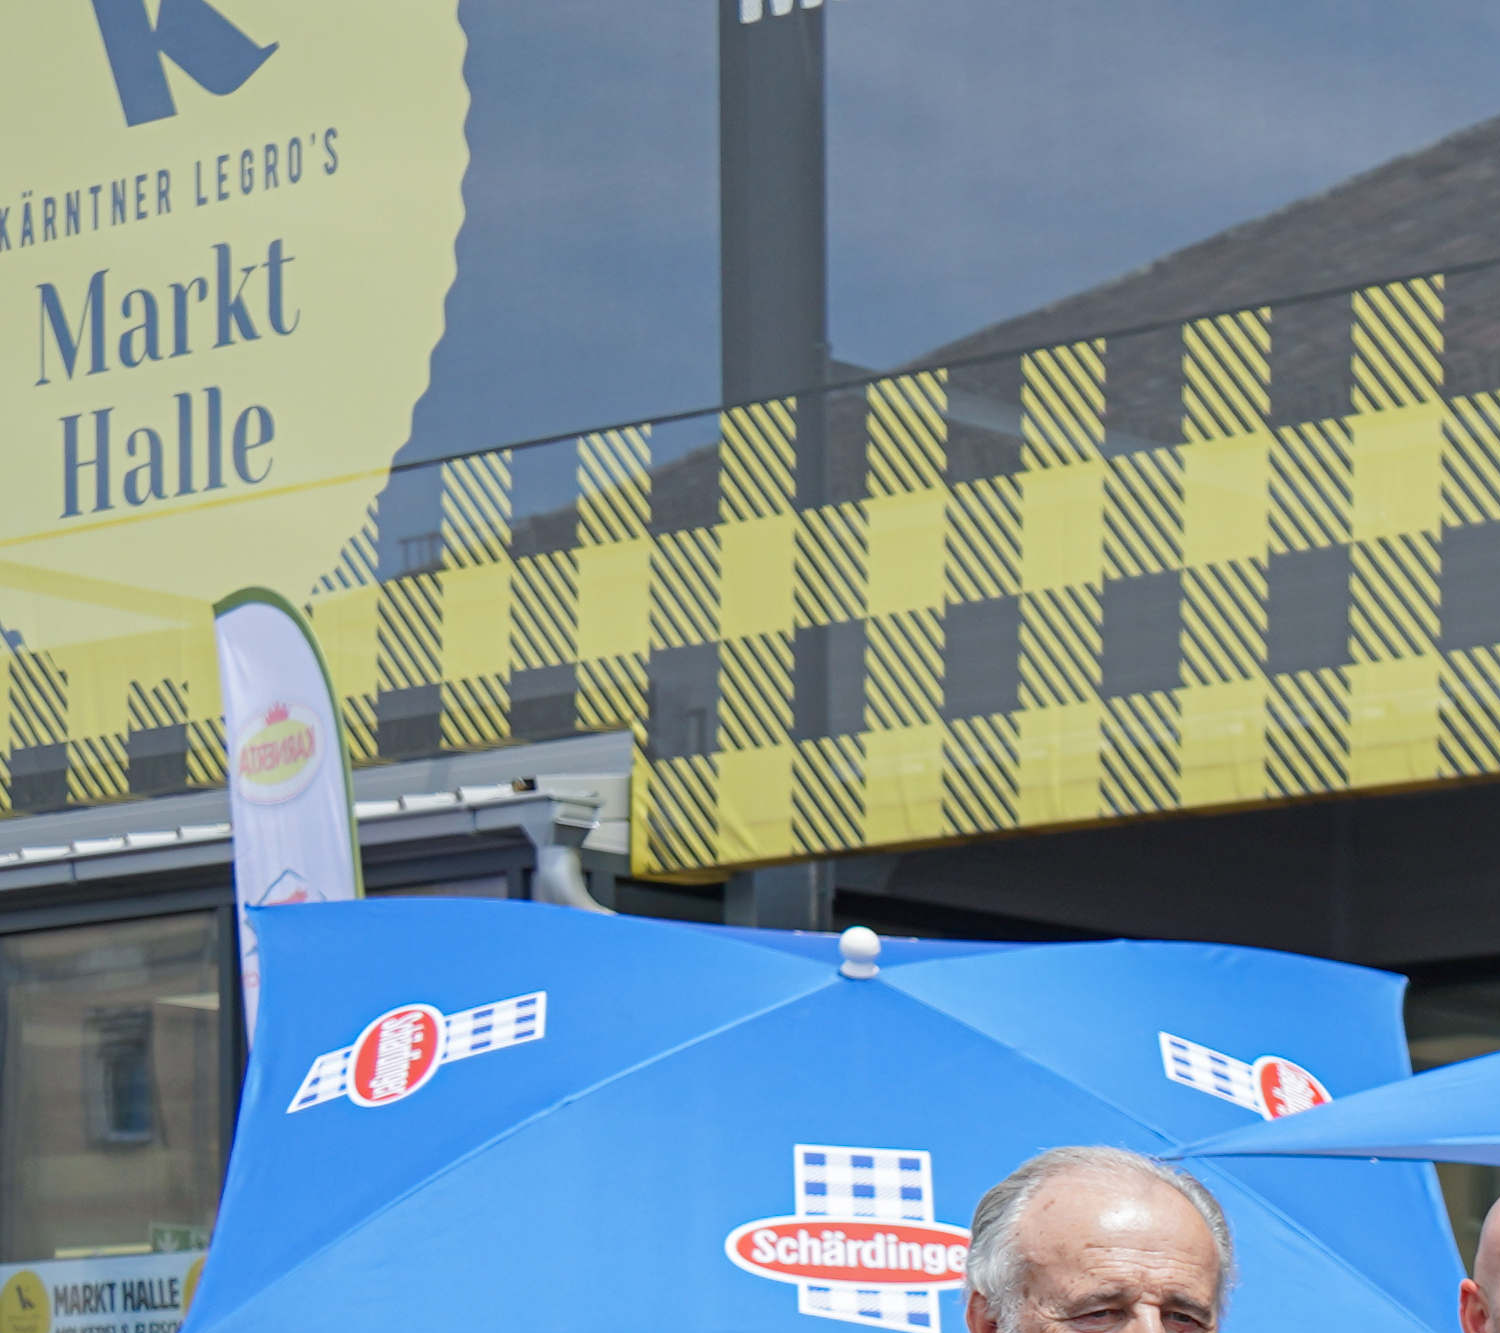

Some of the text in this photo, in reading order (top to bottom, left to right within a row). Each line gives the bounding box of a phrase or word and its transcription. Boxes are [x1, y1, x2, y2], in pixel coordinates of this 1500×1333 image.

[0, 127, 338, 250] KÄRNTNER LEGRO'S
[34, 238, 301, 386] Markt
[58, 386, 276, 519] Halle
[53, 1283, 116, 1317] MARKT
[121, 1278, 180, 1312] HALLE
[751, 1228, 968, 1276] Schärdinge
